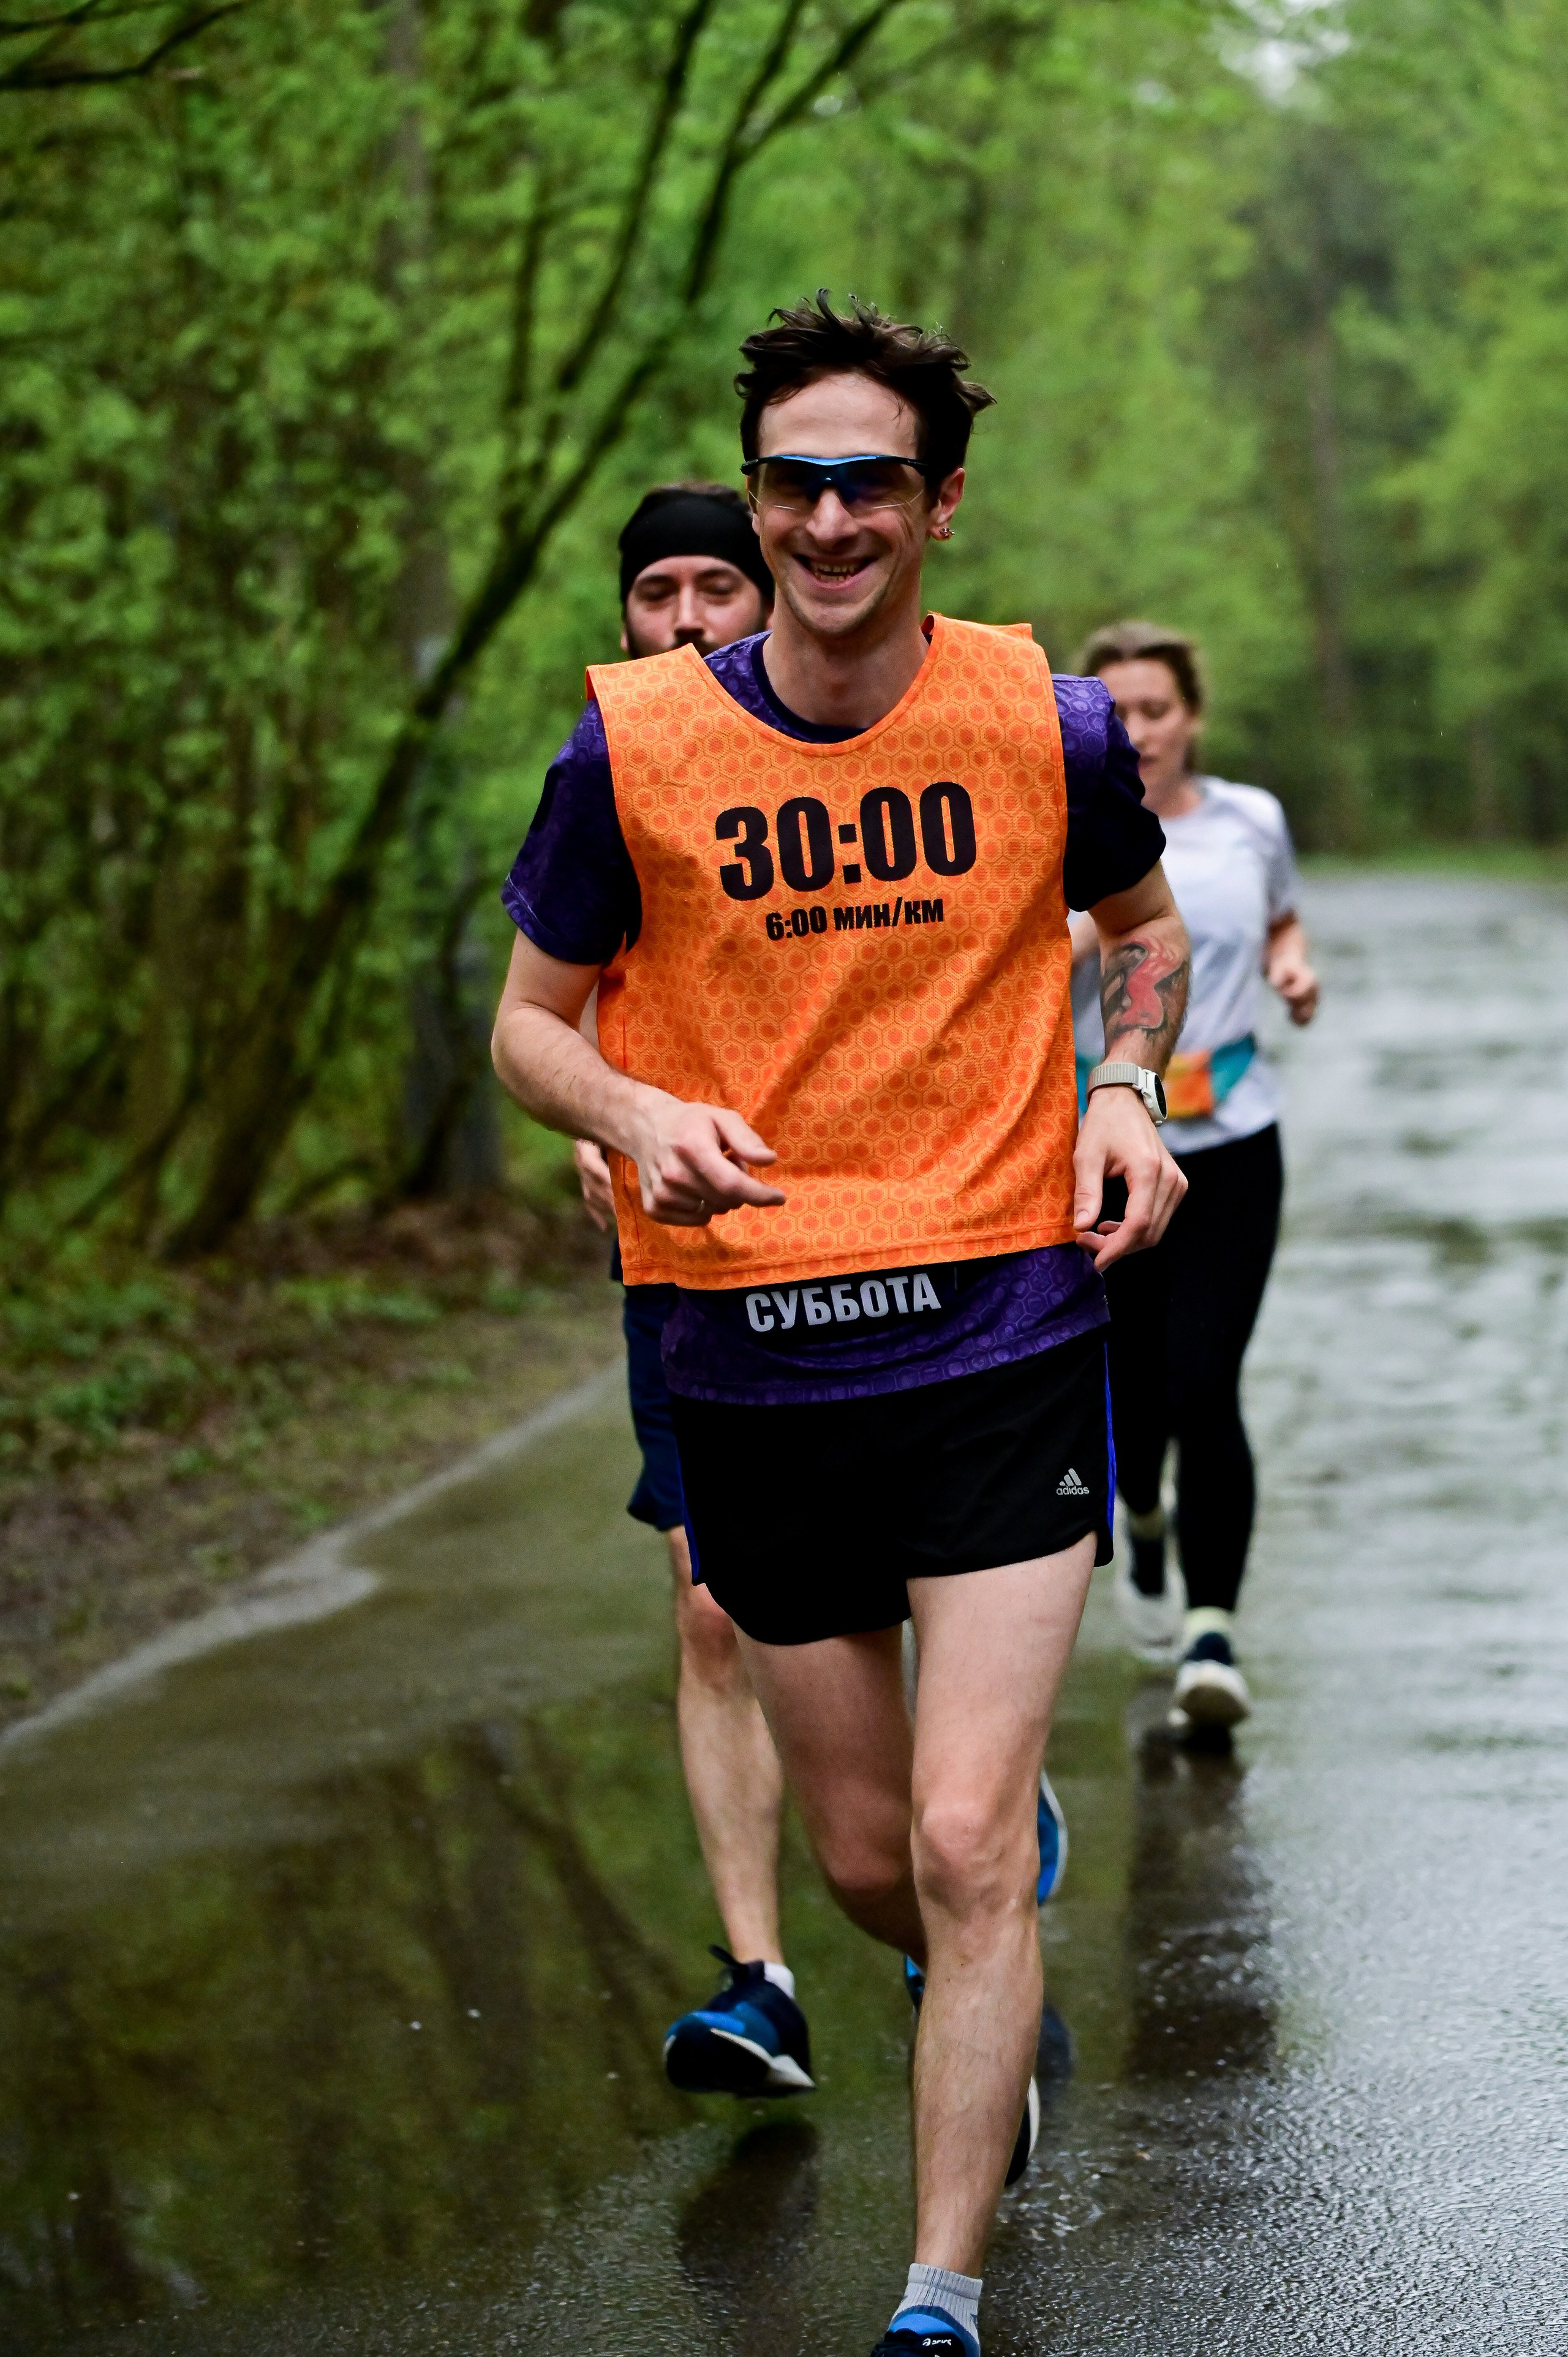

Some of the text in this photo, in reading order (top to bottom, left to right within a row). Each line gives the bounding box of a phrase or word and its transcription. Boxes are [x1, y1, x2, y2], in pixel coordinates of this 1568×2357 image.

[715, 782, 977, 901] 30:00
[766, 906, 827, 941] 6:00
[745, 1273, 941, 1332] СУББОТА
[1056, 1485, 1090, 1496] adidas
